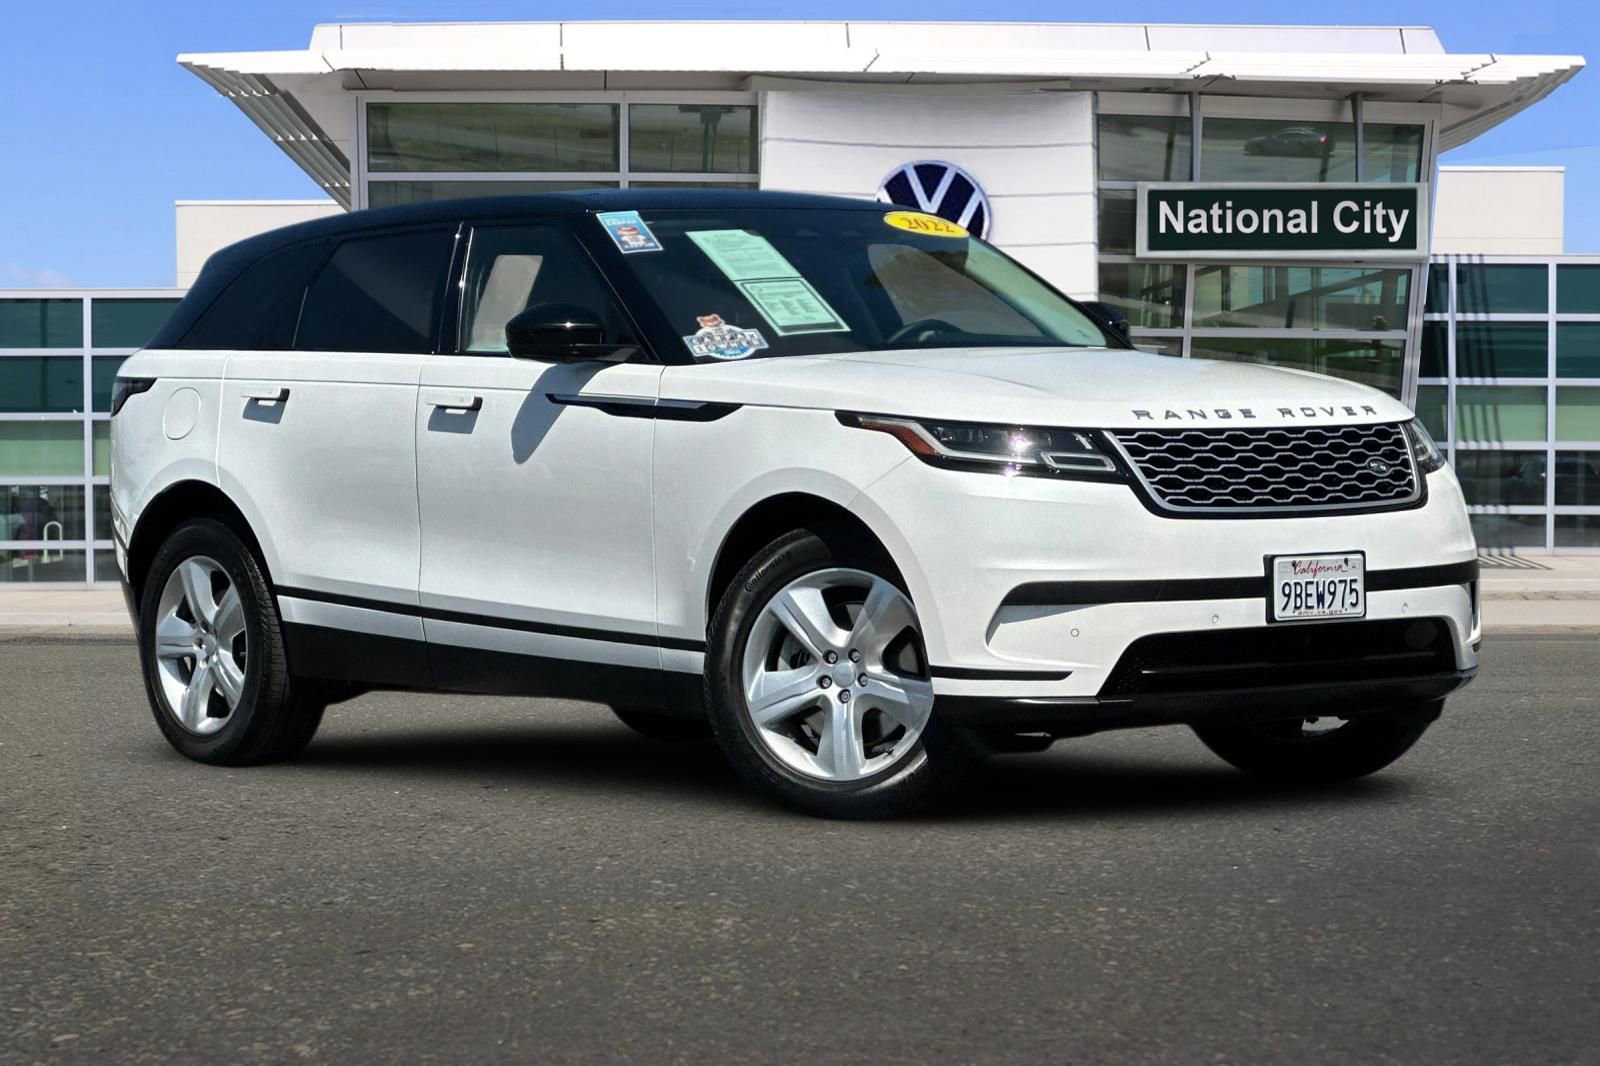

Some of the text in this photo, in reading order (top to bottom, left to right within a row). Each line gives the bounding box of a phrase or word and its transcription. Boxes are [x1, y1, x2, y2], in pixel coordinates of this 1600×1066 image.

[900, 217, 955, 233] 2022
[1159, 200, 1410, 243] National City
[1131, 405, 1378, 421] RANGE ROVER
[1292, 559, 1349, 578] California
[1281, 578, 1359, 611] 9BEW975
